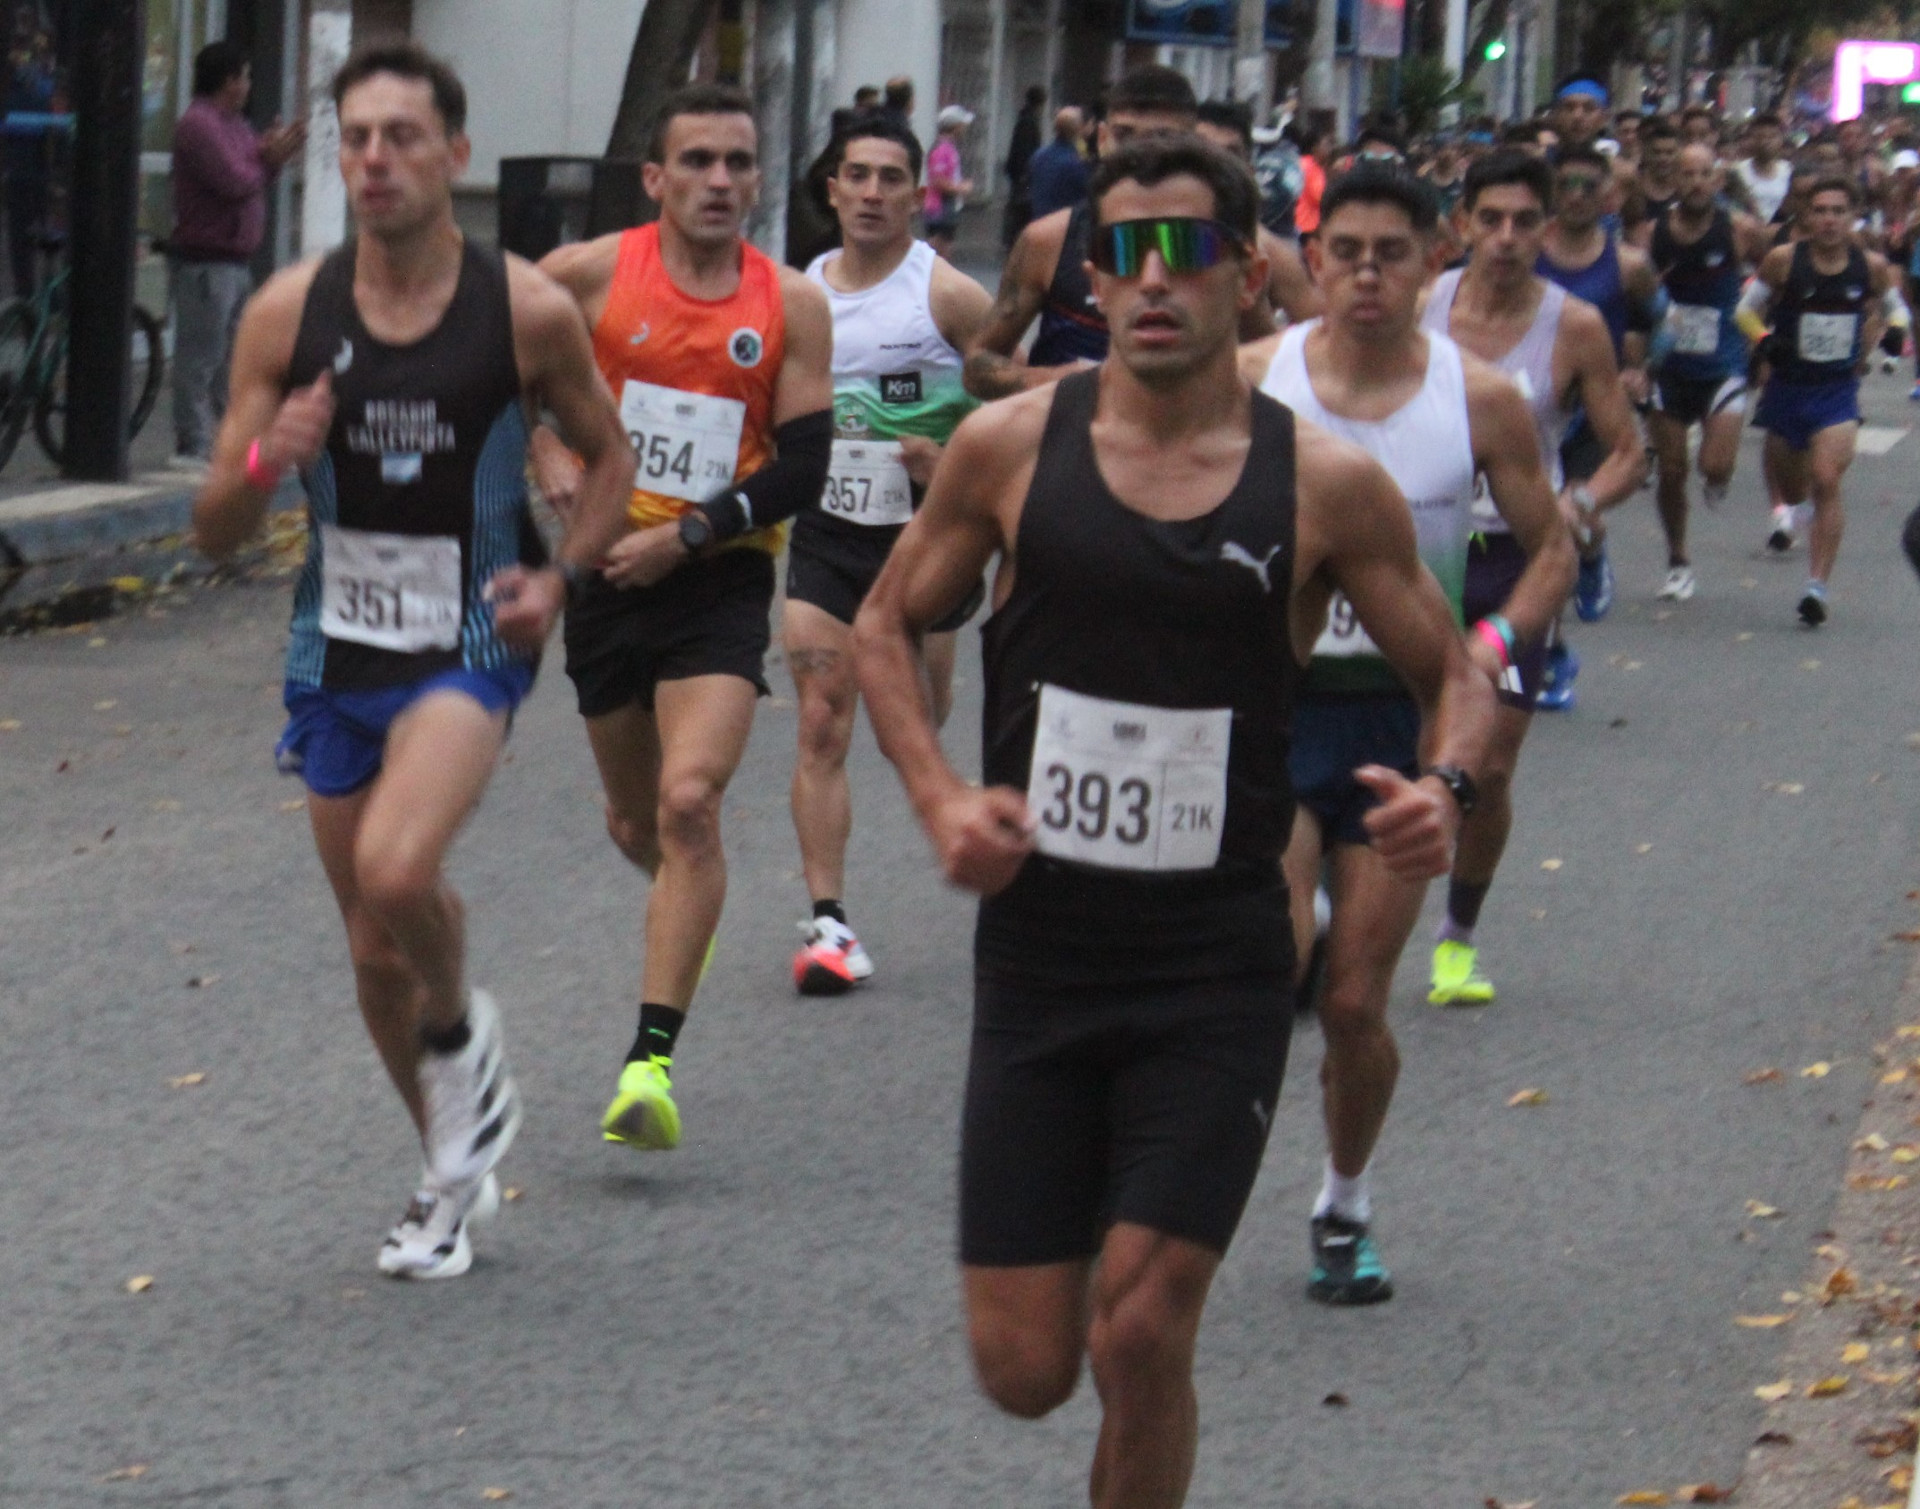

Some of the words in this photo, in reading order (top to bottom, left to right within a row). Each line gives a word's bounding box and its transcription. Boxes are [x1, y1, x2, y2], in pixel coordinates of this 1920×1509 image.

[887, 379, 917, 397] Km
[629, 429, 694, 485] 354
[826, 475, 873, 514] 357
[337, 575, 403, 631] 351
[1041, 762, 1152, 845] 393
[1171, 801, 1214, 832] 21K
